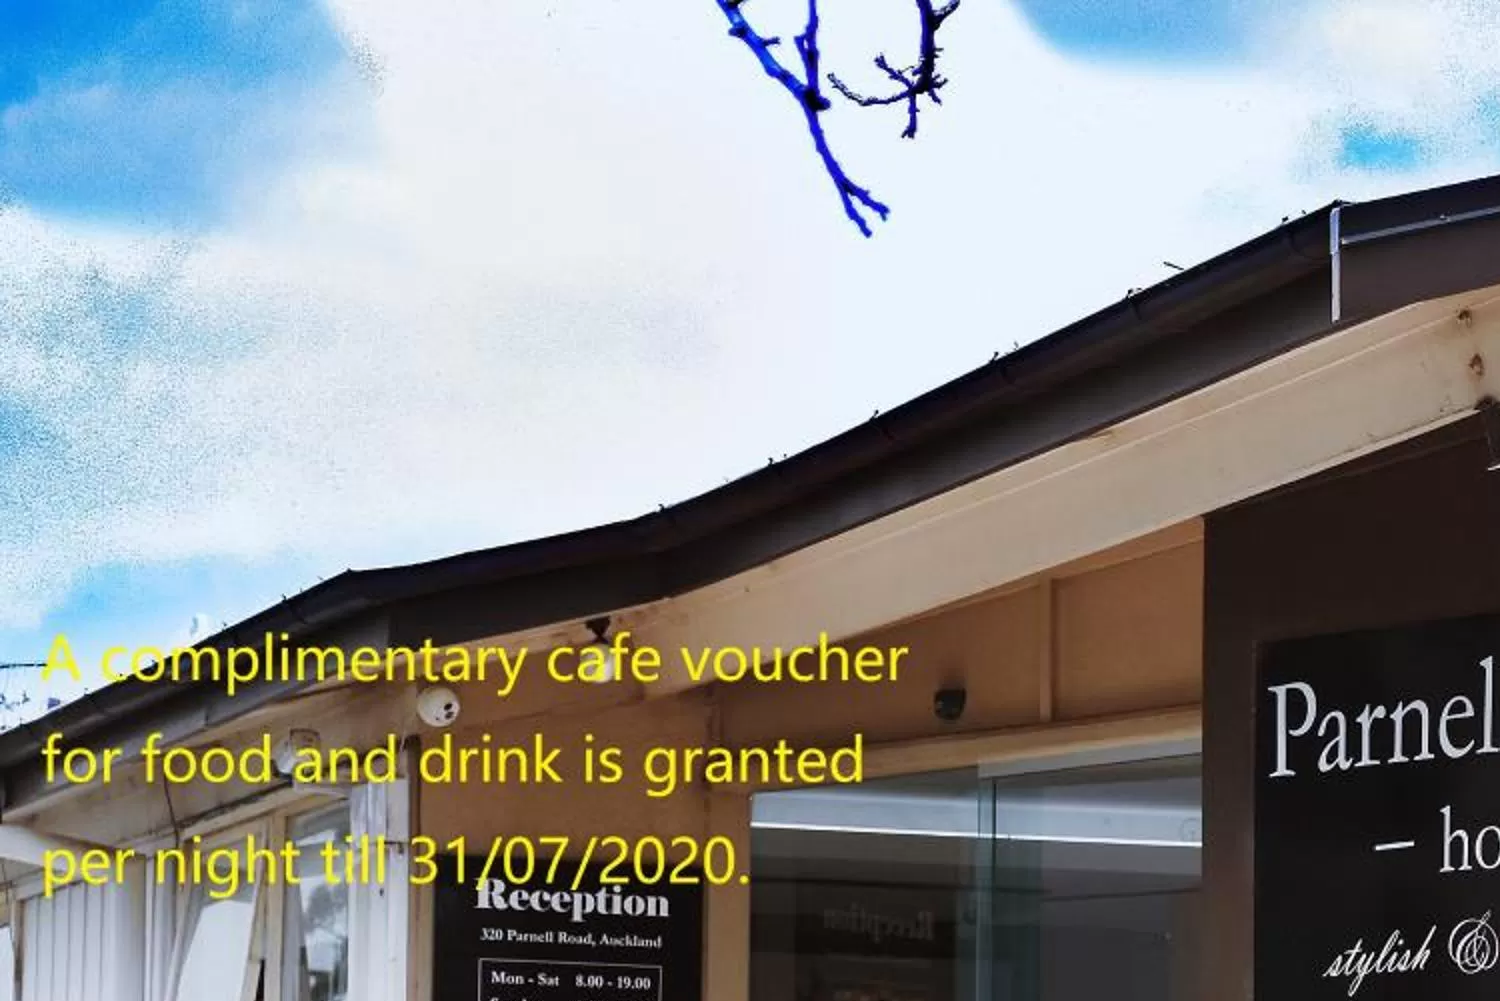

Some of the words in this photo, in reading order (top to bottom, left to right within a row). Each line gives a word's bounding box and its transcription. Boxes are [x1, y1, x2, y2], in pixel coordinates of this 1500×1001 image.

[473, 877, 670, 923] Reception
[480, 928, 503, 941] 320
[507, 929, 554, 943] Parnell
[558, 931, 597, 948] Road,
[599, 933, 663, 948] Auckland
[1322, 924, 1437, 997] stylish
[491, 971, 525, 985] Mon
[538, 973, 560, 987] Sat
[575, 975, 604, 988] 8.00
[617, 976, 651, 990] 19.00
